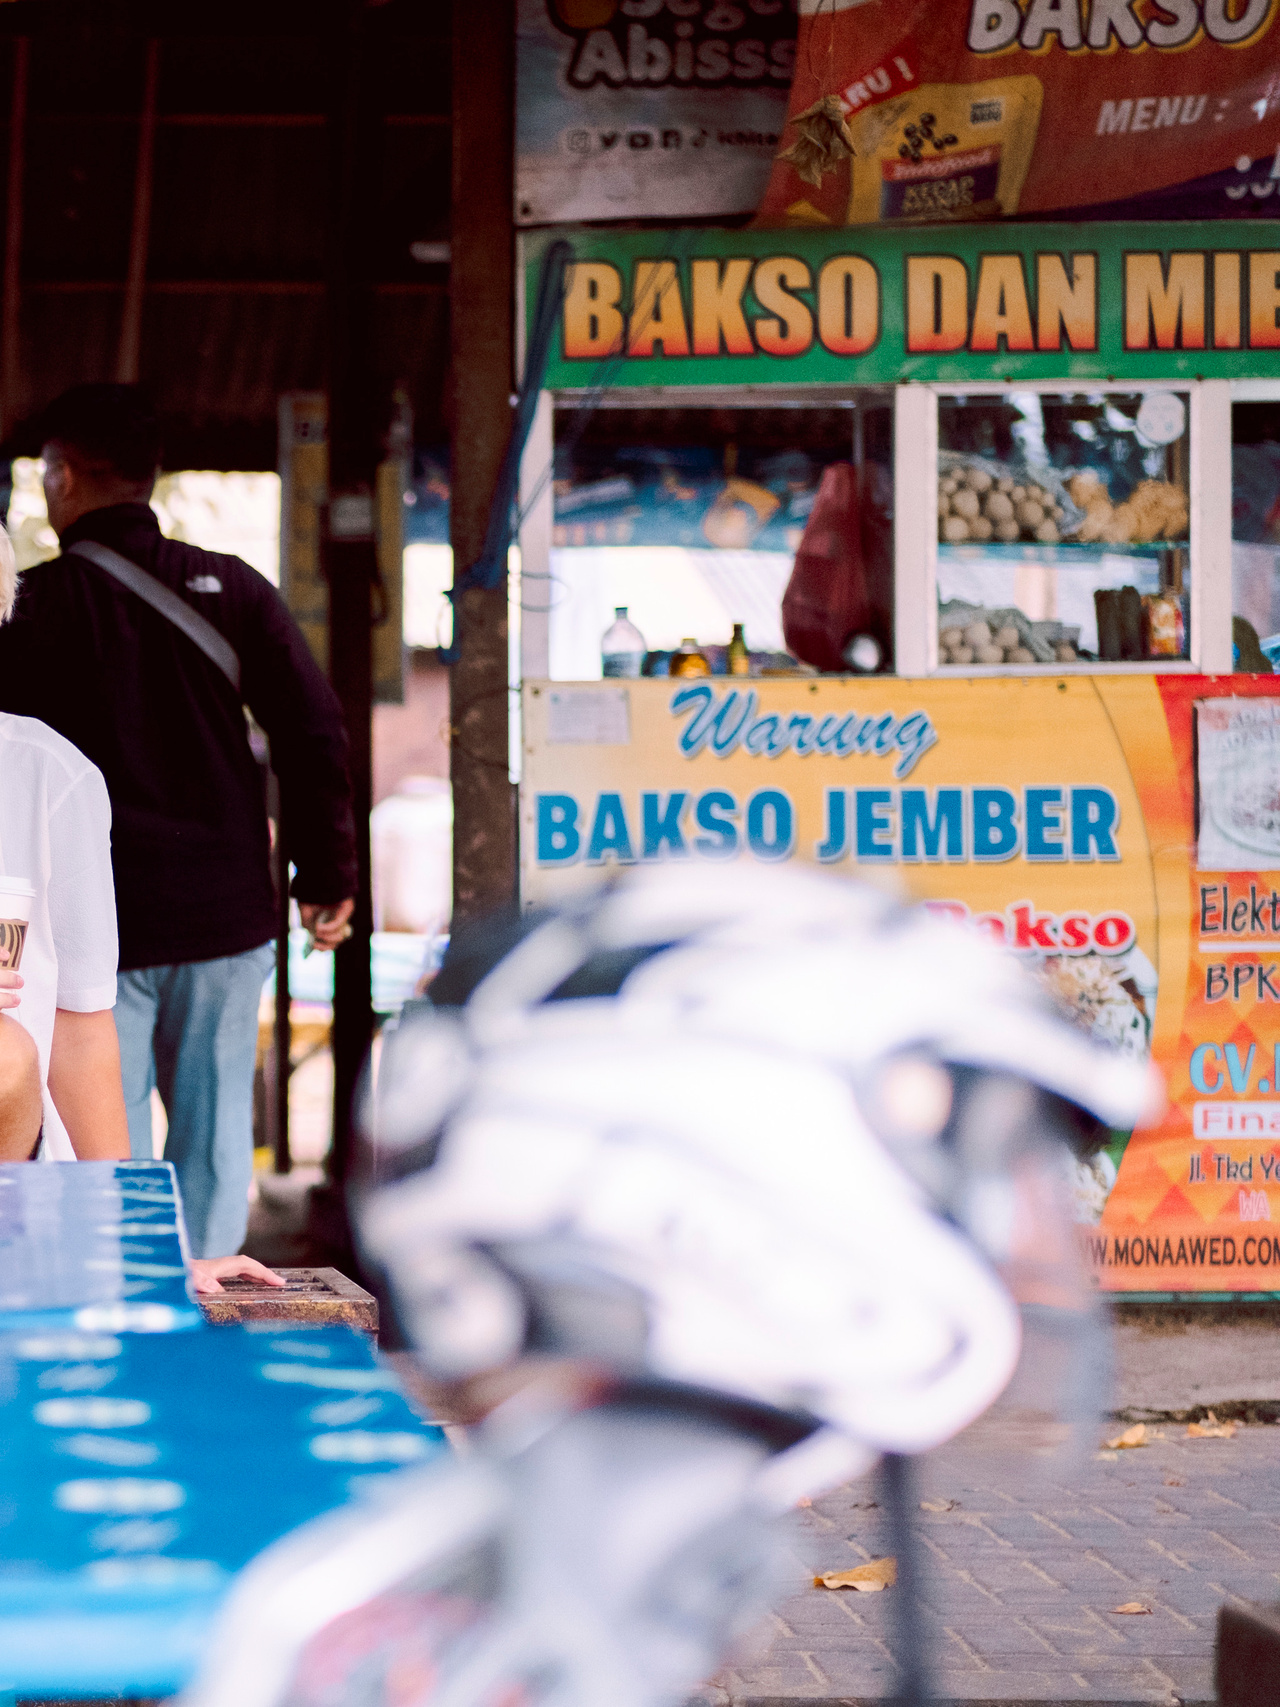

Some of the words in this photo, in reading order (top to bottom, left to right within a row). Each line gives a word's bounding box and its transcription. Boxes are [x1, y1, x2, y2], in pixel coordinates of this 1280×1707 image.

[1096, 94, 1208, 135] MENU
[562, 254, 882, 360] BAKSO
[906, 252, 1098, 353] DAN
[1124, 250, 1280, 352] MIE
[671, 683, 937, 780] Warung
[536, 788, 796, 864] BAKSO
[818, 785, 1120, 864] JEMBER
[926, 898, 1136, 952] akso
[1189, 1041, 1280, 1094] CV.
[1239, 1190, 1271, 1222] WA
